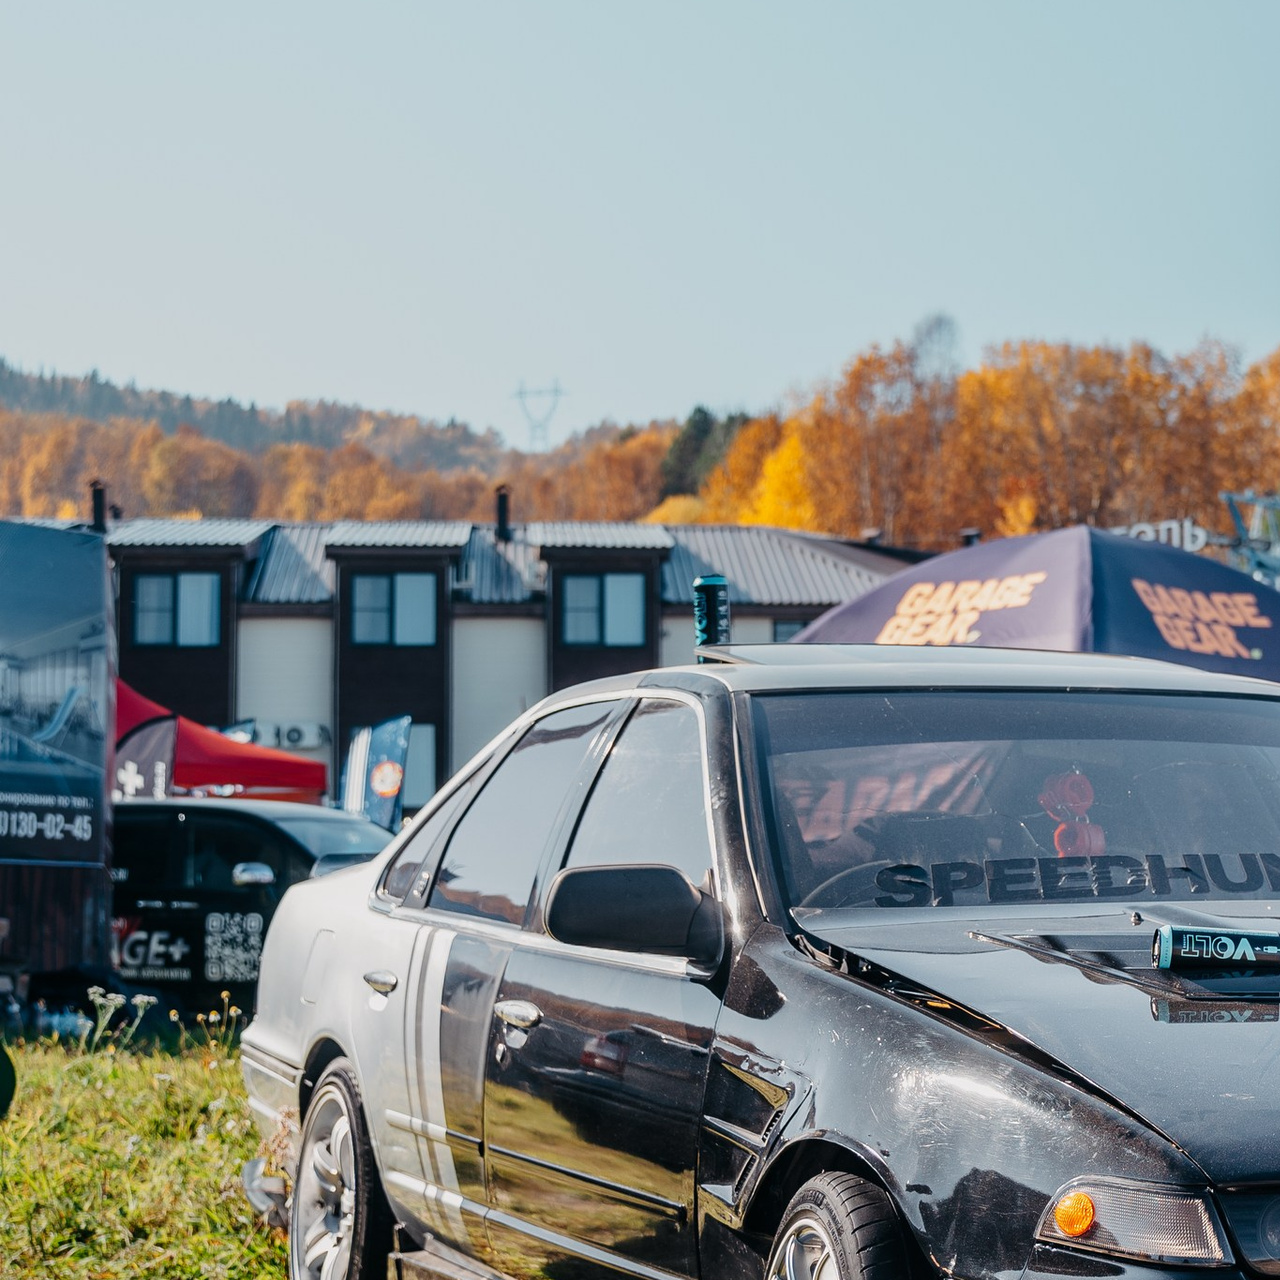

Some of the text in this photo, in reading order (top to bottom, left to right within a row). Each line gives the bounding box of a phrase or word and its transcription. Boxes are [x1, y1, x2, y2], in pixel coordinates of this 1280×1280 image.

[897, 571, 1048, 617] GARAGE
[1131, 578, 1272, 628] GARAGE
[1181, 934, 1256, 961] VOLT
